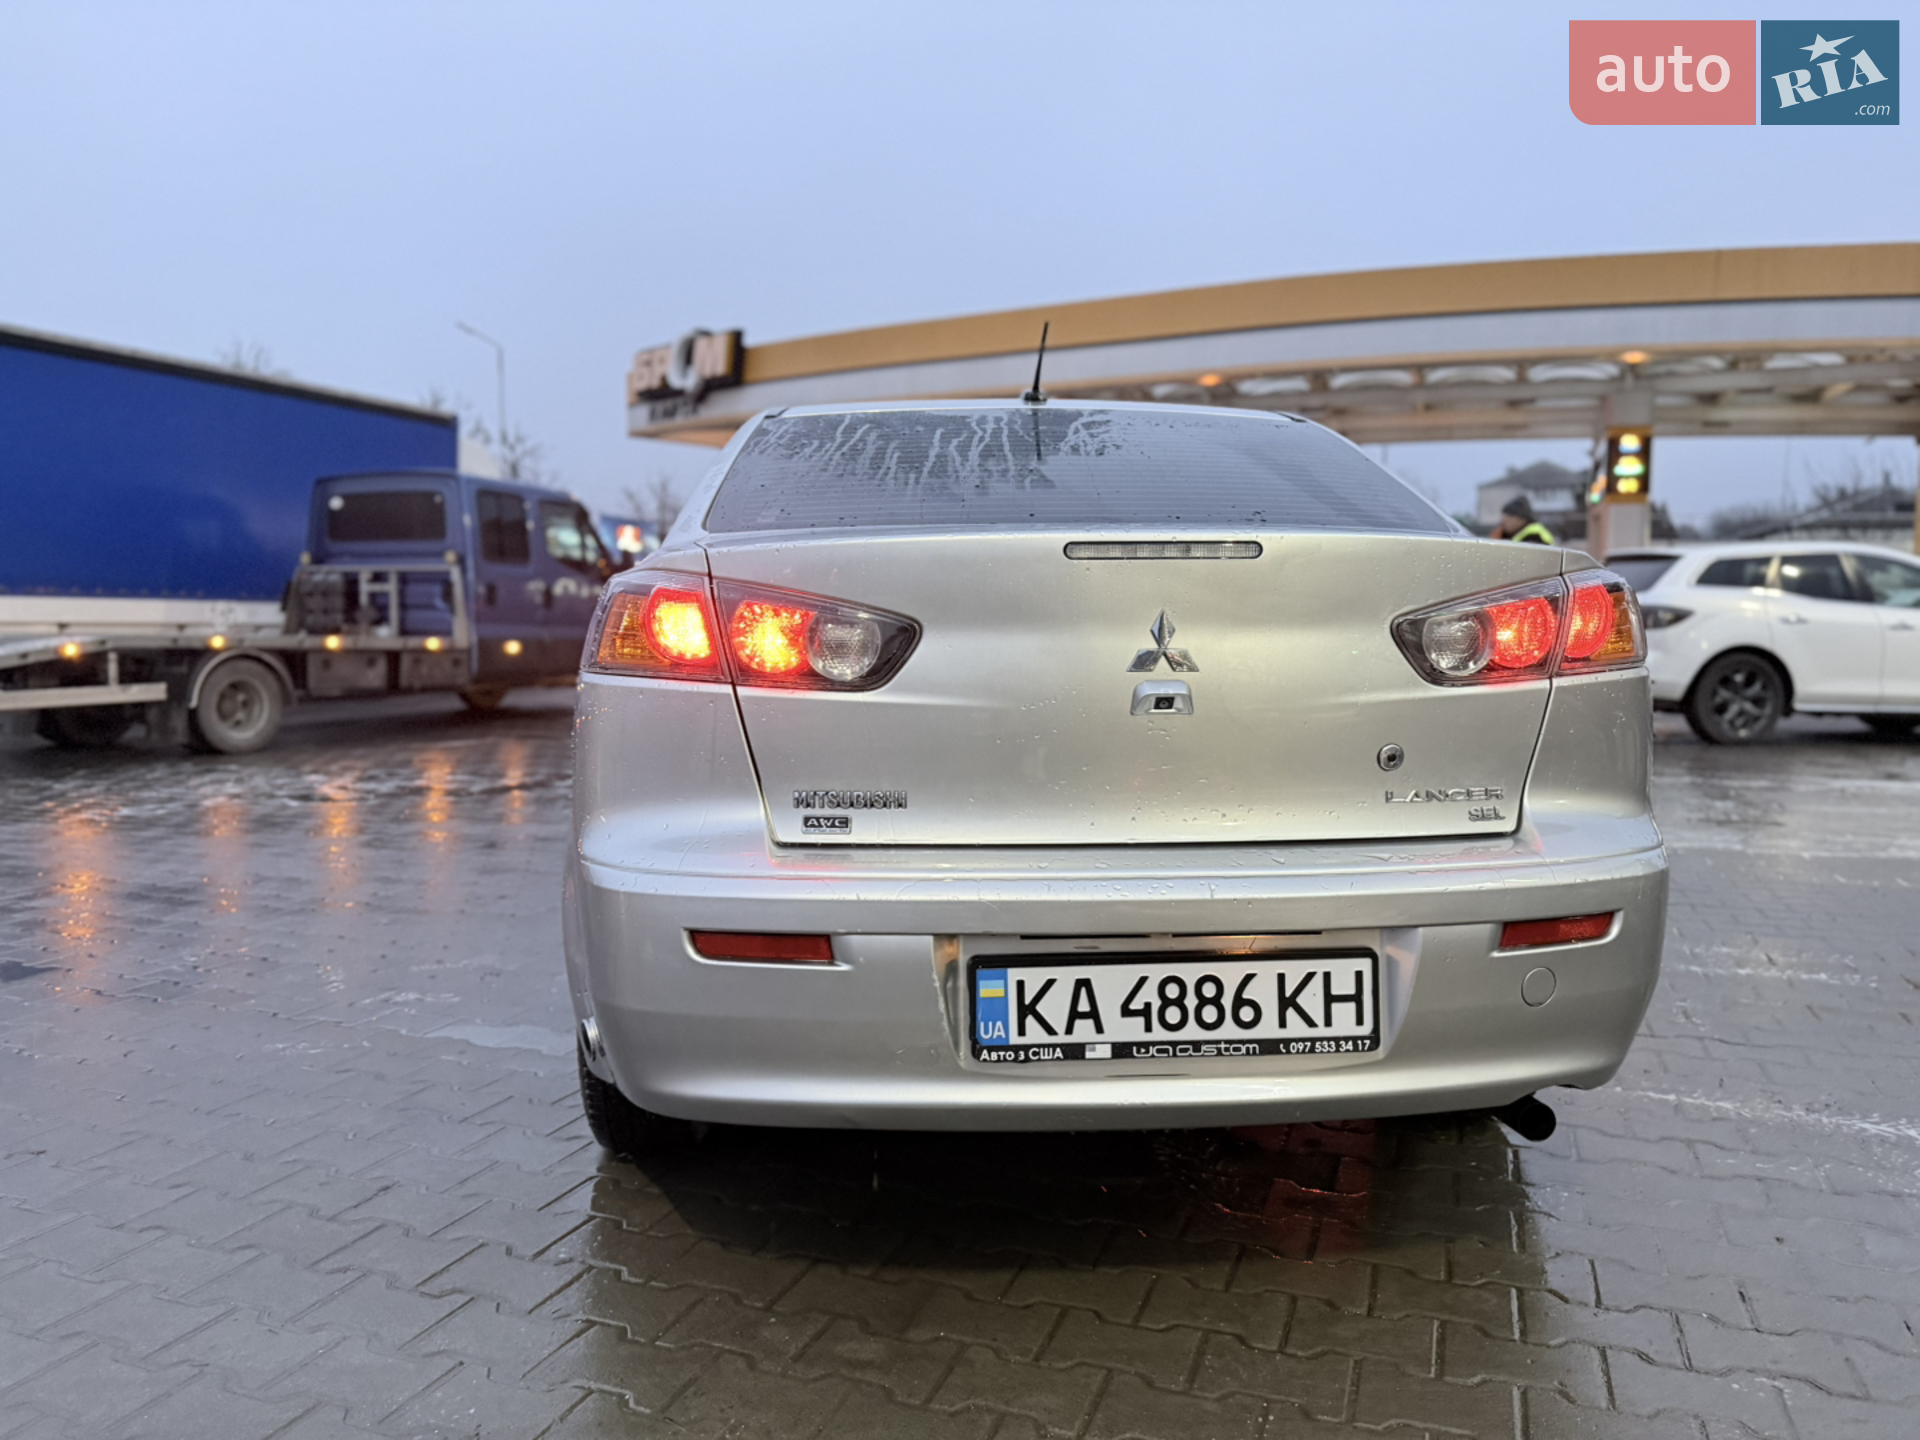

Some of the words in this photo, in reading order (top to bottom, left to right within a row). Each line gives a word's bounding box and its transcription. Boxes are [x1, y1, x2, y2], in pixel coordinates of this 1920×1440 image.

[792, 789, 908, 810] MITSUBISHI
[1384, 787, 1504, 804] LANCER
[1467, 805, 1506, 822] SEL
[805, 817, 848, 829] AWC
[1015, 977, 1105, 1037] KA
[1120, 972, 1263, 1034] 4886
[1276, 969, 1365, 1031] KH
[979, 1020, 1007, 1040] UA
[979, 1049, 1015, 1062] Авто
[1028, 1047, 1064, 1060] США
[1289, 1041, 1313, 1053] 097
[1315, 1040, 1336, 1053] 533
[1338, 1040, 1354, 1052] 34
[1356, 1039, 1371, 1051] 17
